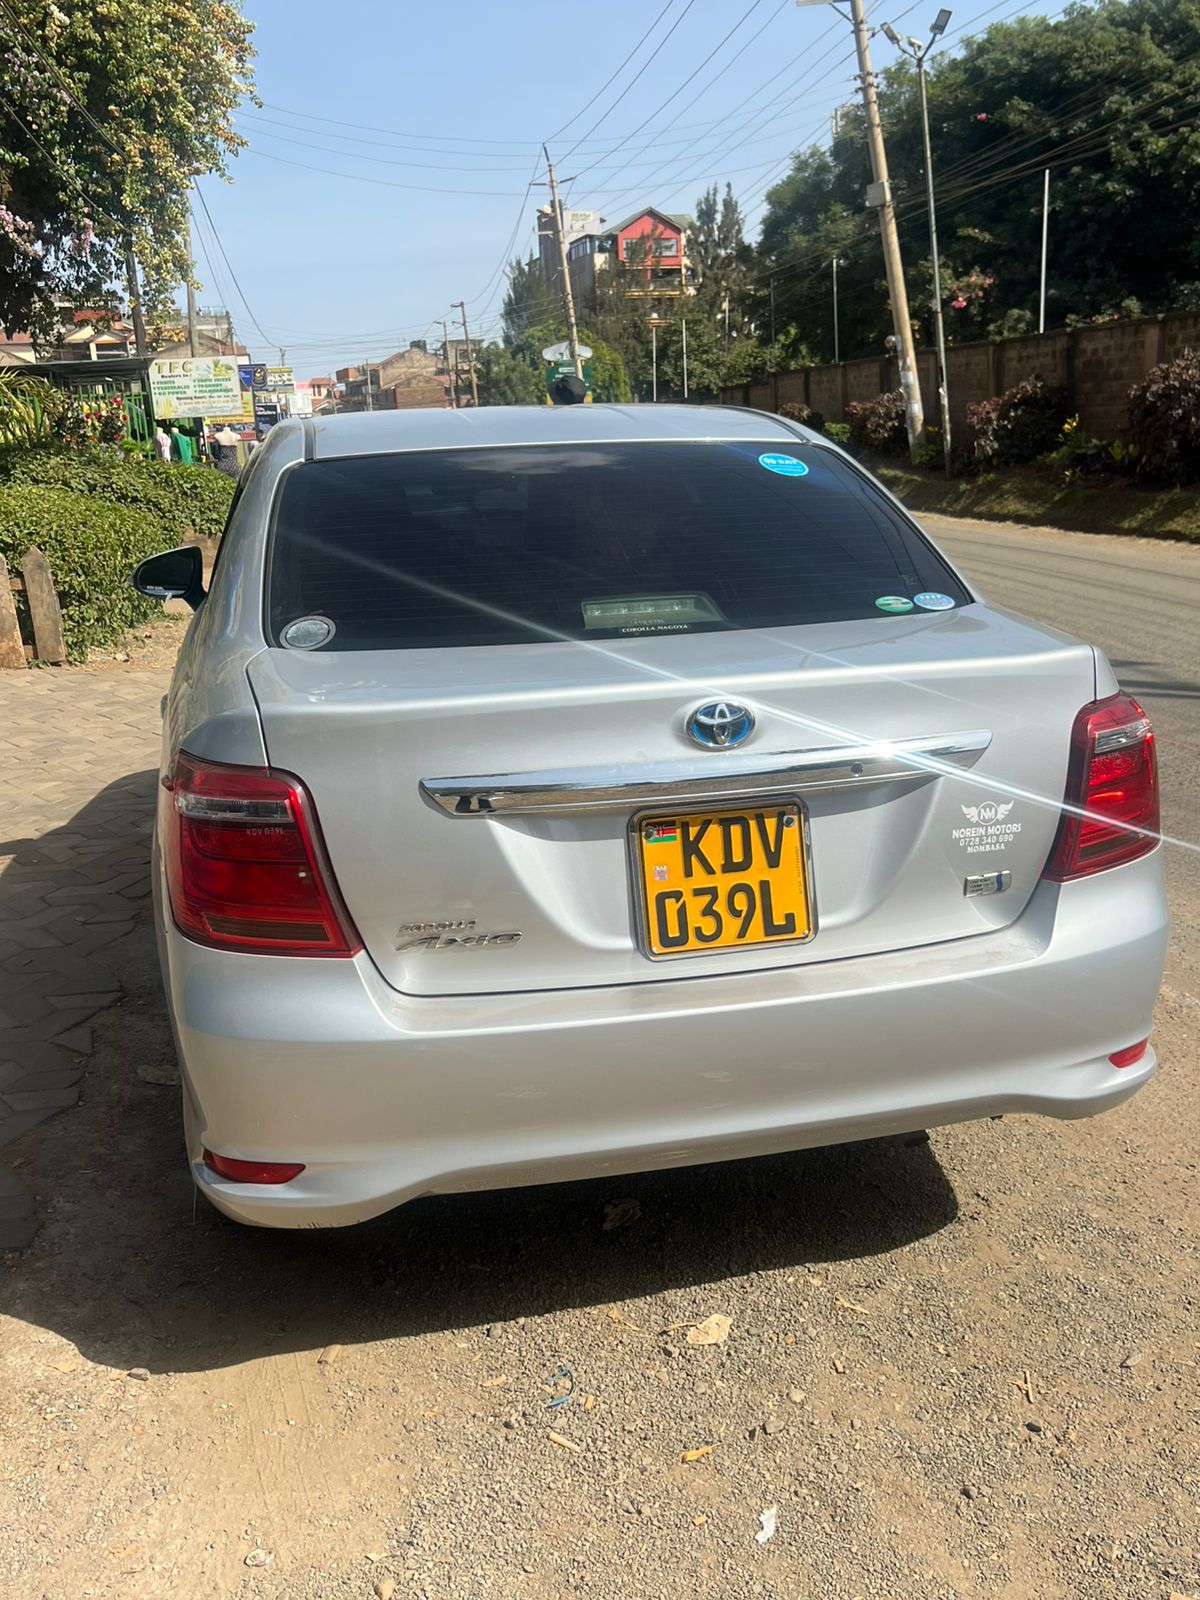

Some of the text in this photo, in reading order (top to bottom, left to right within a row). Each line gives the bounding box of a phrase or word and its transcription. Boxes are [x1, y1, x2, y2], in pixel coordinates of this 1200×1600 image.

[621, 625, 656, 633] COROLLA
[952, 823, 1022, 839] NOREIN MOTORS
[681, 811, 786, 878] KDV
[981, 835, 997, 845] 340
[966, 843, 1006, 854] MOMBASA
[655, 879, 797, 949] 039L
